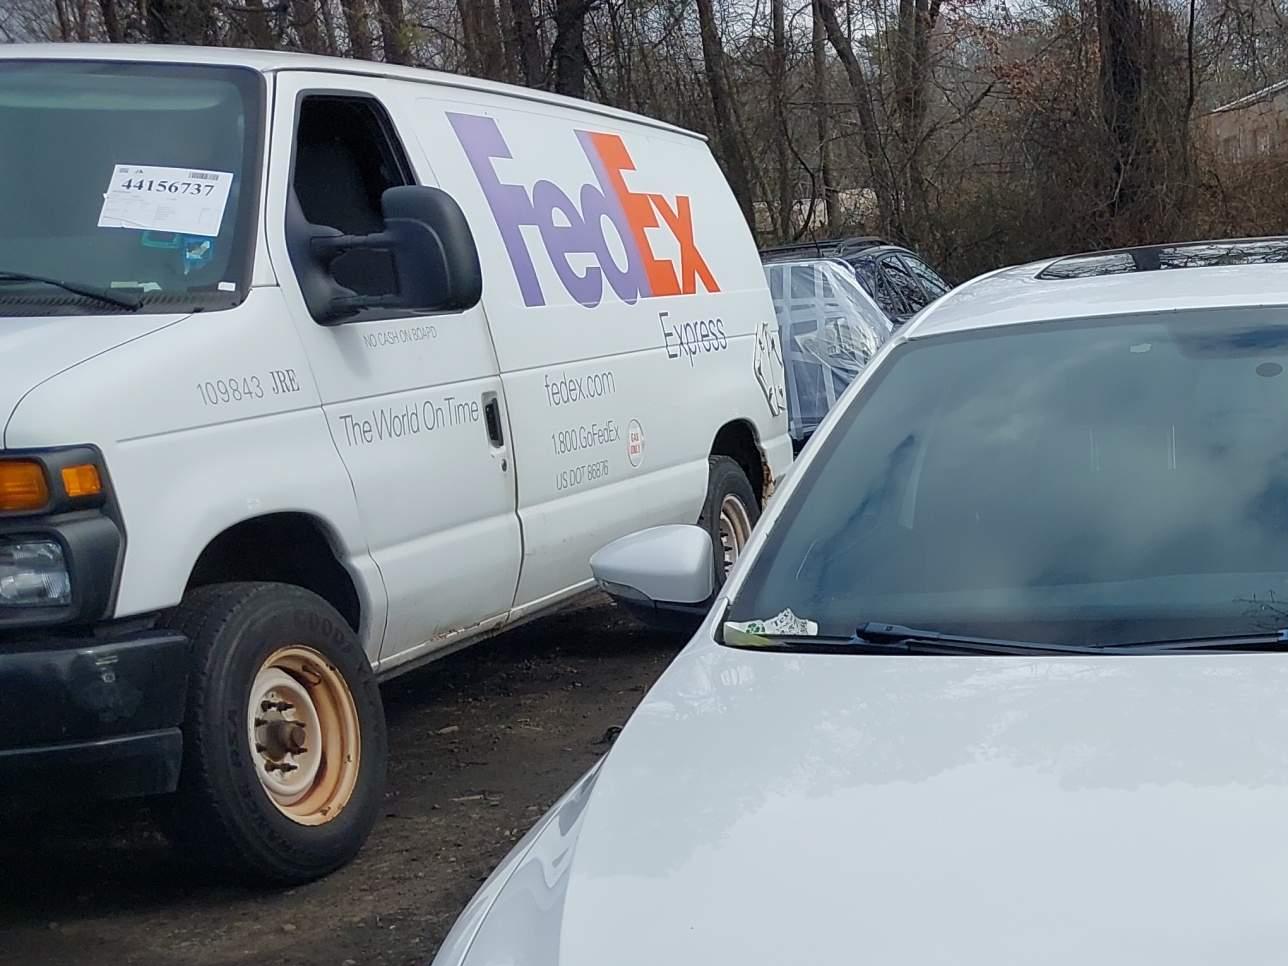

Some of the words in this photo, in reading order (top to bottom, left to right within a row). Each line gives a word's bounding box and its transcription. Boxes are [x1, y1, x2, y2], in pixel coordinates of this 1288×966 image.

[121, 178, 216, 197] 44156737
[445, 111, 721, 308] FedEx
[363, 334, 378, 347] NO
[659, 312, 727, 368] Express
[196, 375, 264, 407] 109843
[269, 368, 300, 395] JRE
[544, 370, 616, 407] fedex.com
[340, 414, 373, 447] The
[371, 404, 419, 444] World
[422, 400, 444, 431] On
[444, 397, 480, 427] Time
[551, 420, 621, 455] 1.800.GoFedEx
[556, 471, 568, 490] US
[569, 465, 587, 487] DOT
